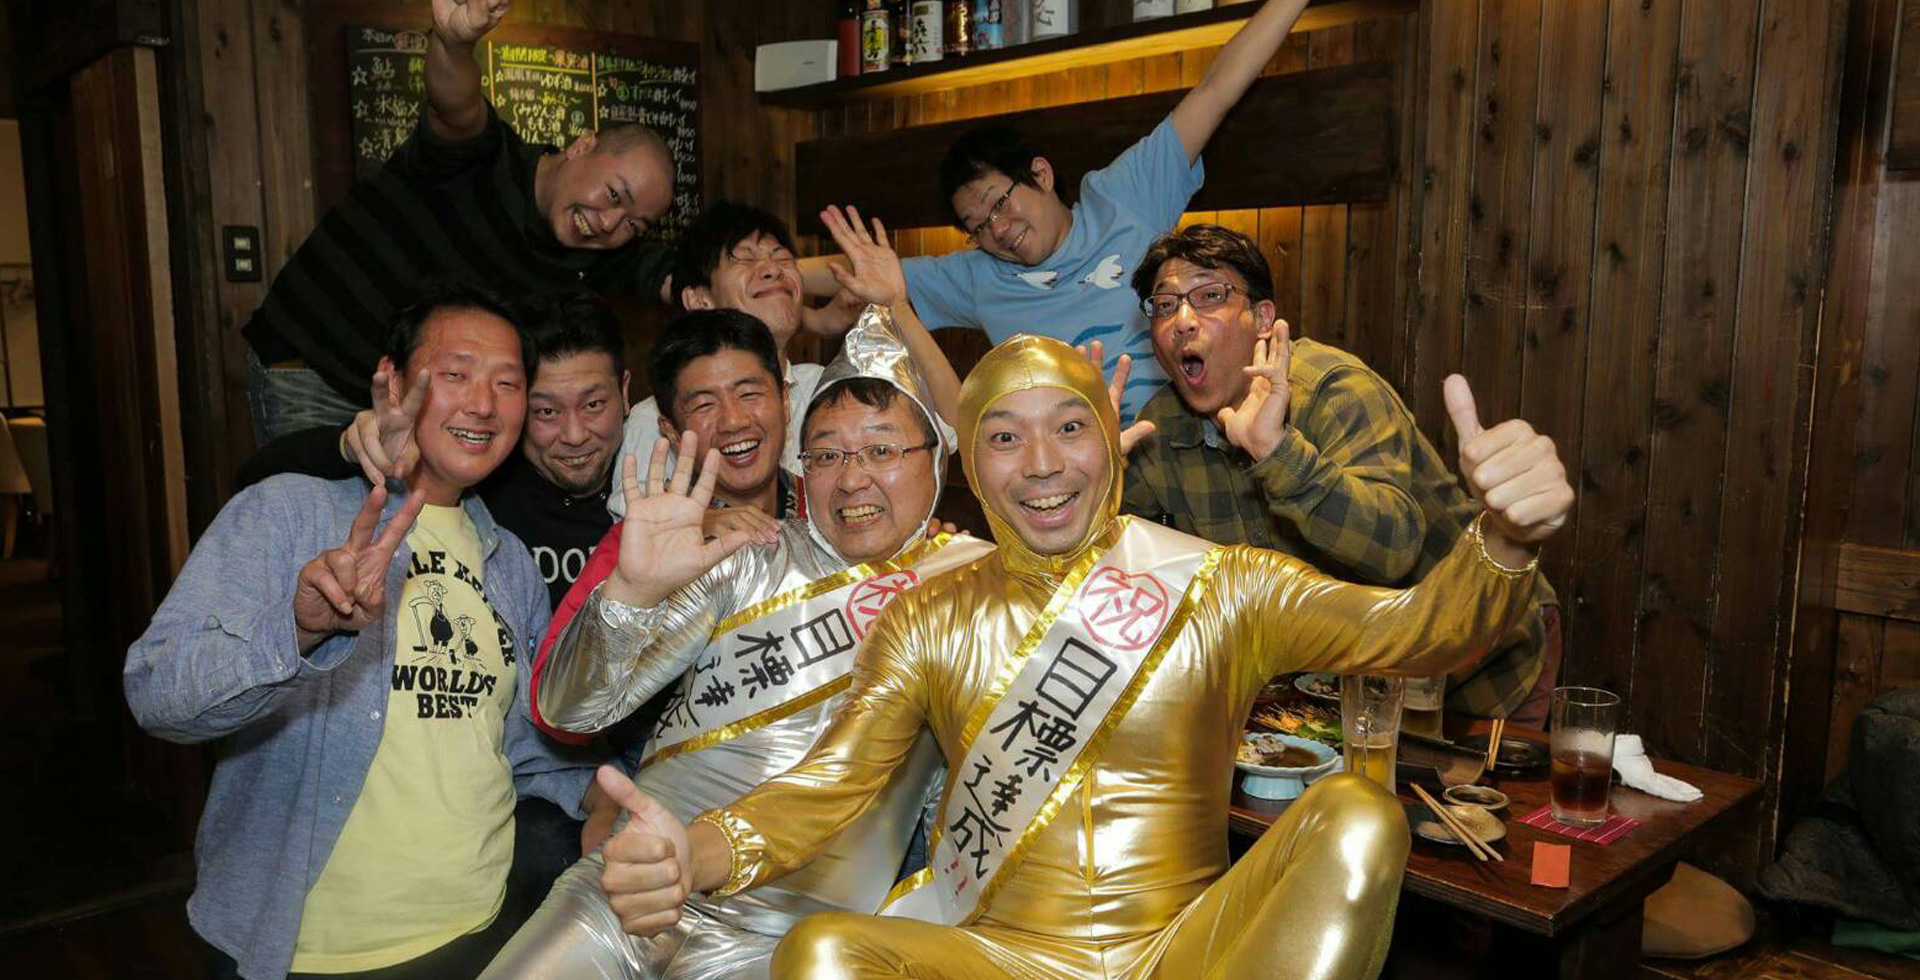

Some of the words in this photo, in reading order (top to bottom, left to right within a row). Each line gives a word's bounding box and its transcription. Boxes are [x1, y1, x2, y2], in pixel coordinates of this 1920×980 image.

[407, 550, 446, 580] LE
[1079, 566, 1169, 651] 祝
[416, 693, 478, 719] BEST
